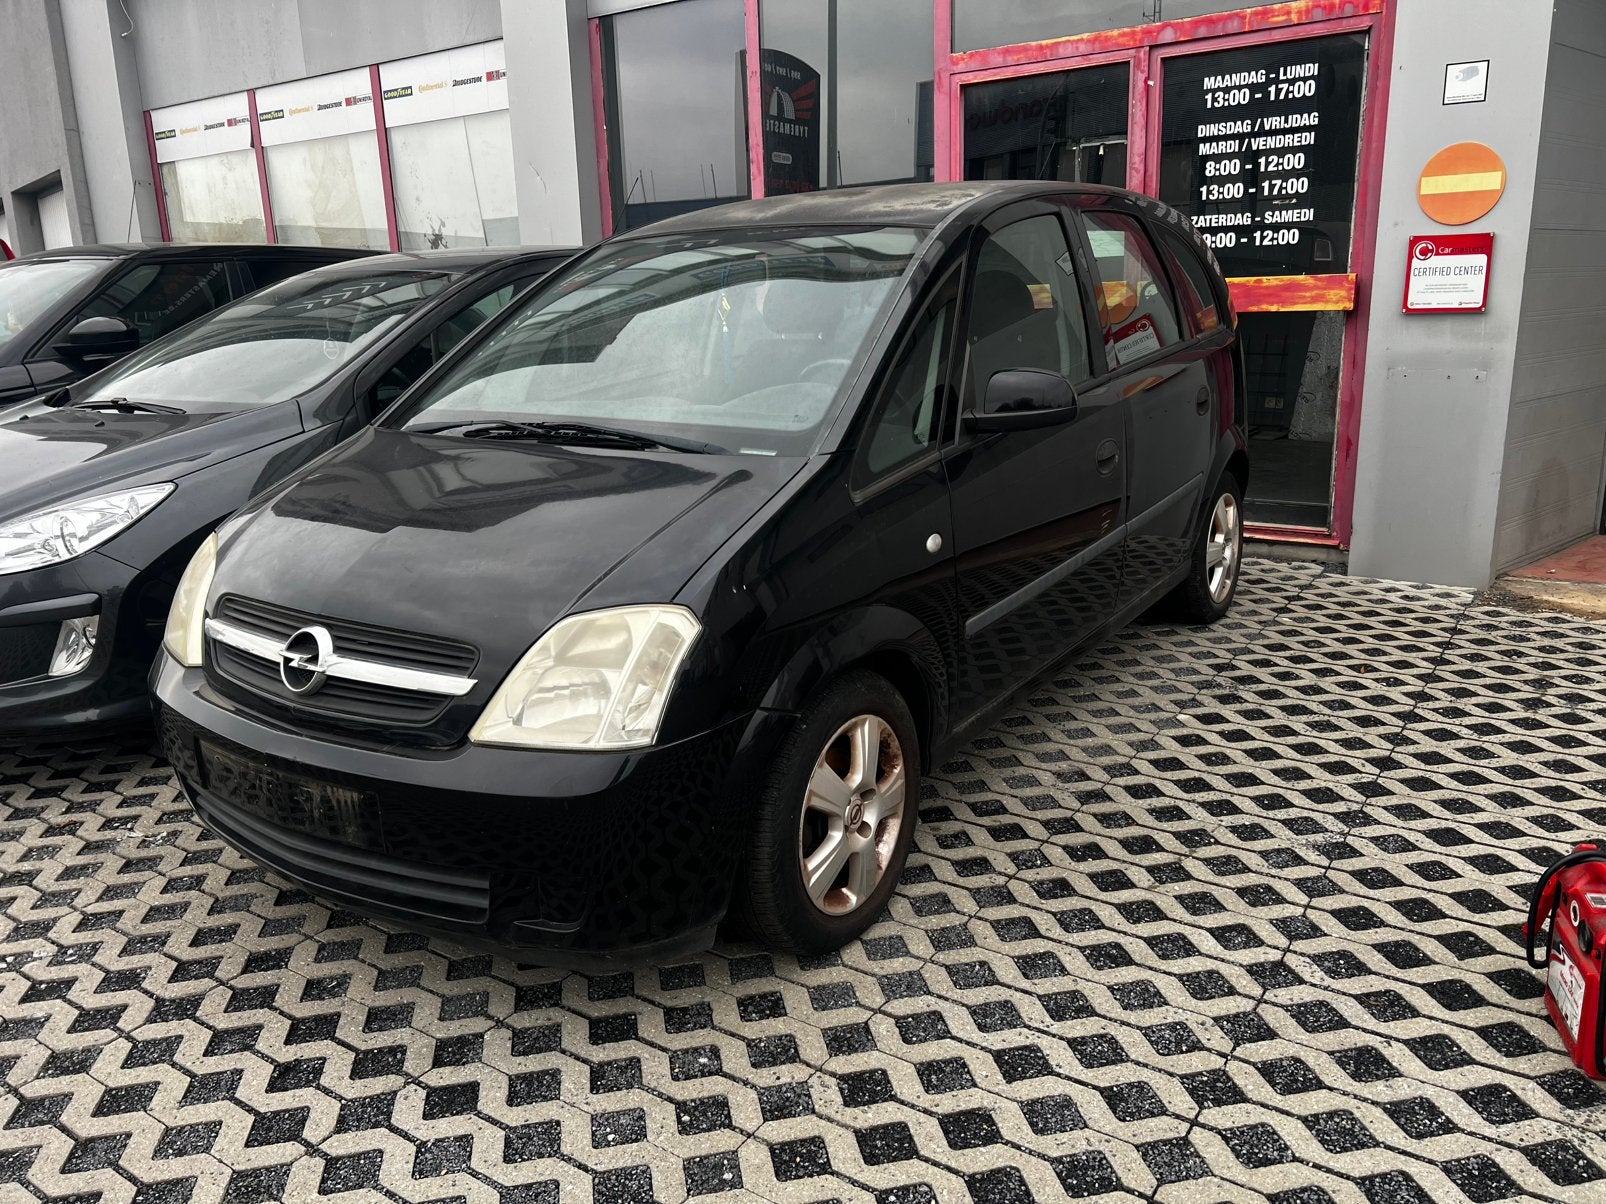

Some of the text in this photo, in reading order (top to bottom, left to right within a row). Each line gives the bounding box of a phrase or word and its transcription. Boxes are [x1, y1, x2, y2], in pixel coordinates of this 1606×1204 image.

[384, 87, 412, 98] GOODYEAR
[452, 76, 483, 87] BRIDGESTONE
[1203, 69, 1266, 90] MAANDAG
[1279, 63, 1319, 80] LUNDI
[1205, 88, 1250, 109] 13:00
[1268, 80, 1316, 101] 17:00
[1197, 112, 1319, 138] DINSDAG / VRIJDAG
[1199, 132, 1315, 156] MARDI / VENDREDI
[1205, 159, 1241, 177] 8:00
[1258, 153, 1305, 172] 12:00
[1200, 183, 1244, 201] 13:00
[1261, 177, 1309, 196] 17:00
[1191, 213, 1252, 228] ZATERDAG
[1264, 208, 1315, 224] SAMEDI
[1253, 228, 1300, 246] 12:00
[1413, 265, 1484, 277] CERTIFIED CENTER
